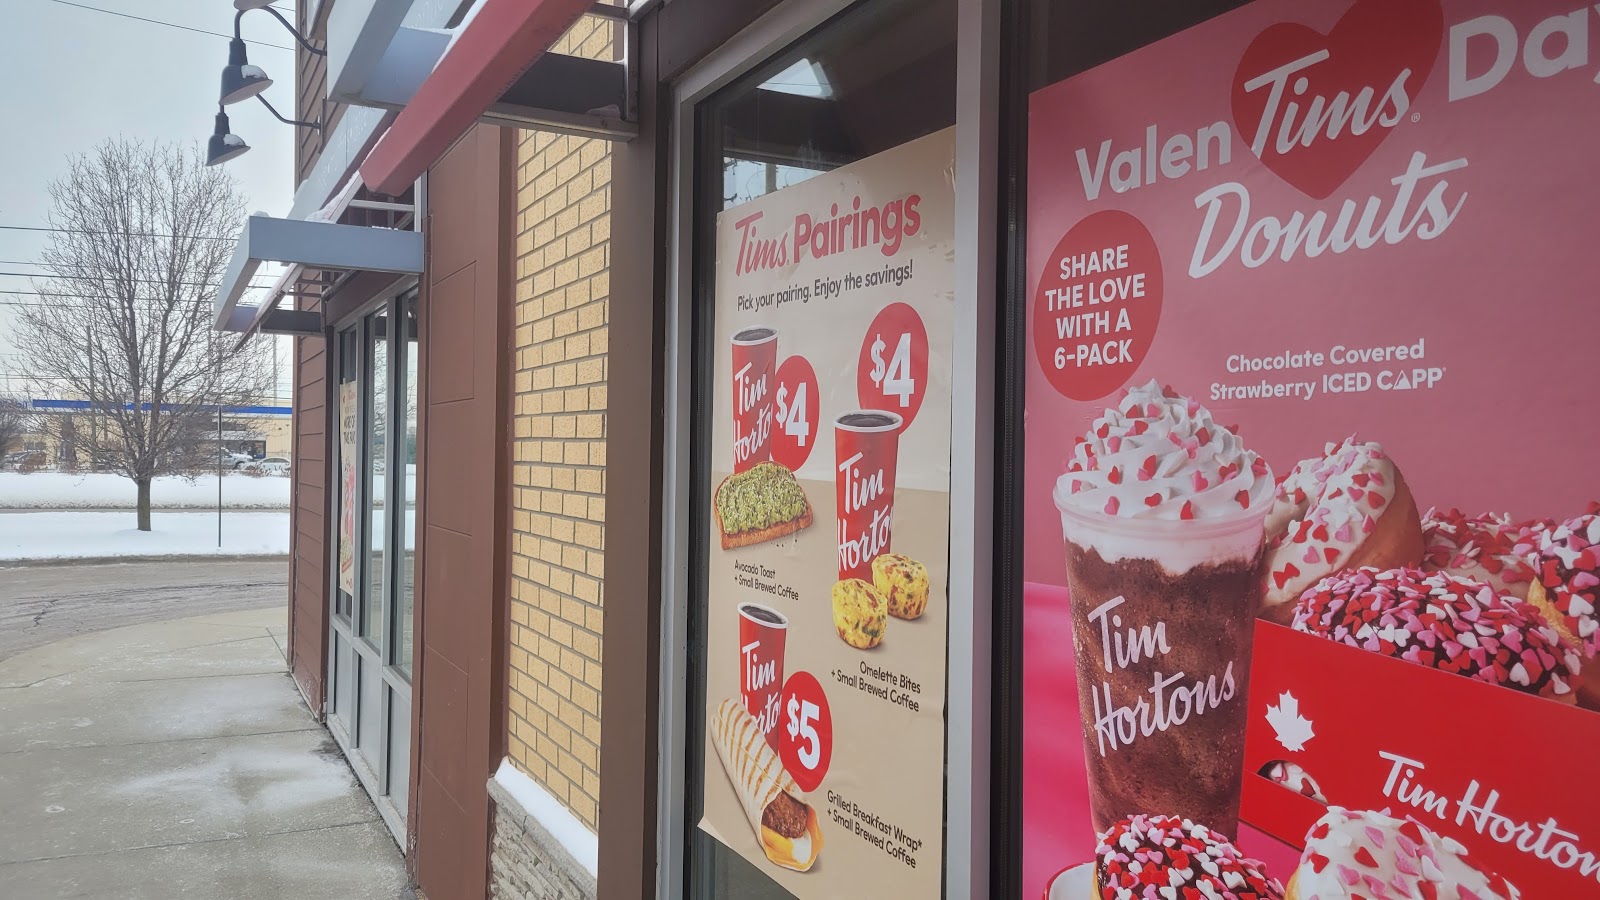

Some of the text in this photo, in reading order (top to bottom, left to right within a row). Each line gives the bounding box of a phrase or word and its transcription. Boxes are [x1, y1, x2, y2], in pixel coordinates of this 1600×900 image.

[793, 194, 921, 264] Pairings
[1188, 150, 1469, 279] Donuts
[737, 259, 913, 312] Pick your pairing. Enjoy the savings!
[1059, 244, 1129, 280] SHARE
[1045, 273, 1145, 312] THE LOVE
[1056, 307, 1132, 340] WITH A
[869, 333, 915, 408] $4
[1054, 339, 1133, 370] 6-PACK
[1226, 338, 1425, 373] Chocolate Covered
[734, 361, 767, 416] Tim
[1209, 380, 1316, 401] Strawberry
[1322, 372, 1372, 394] ICED
[775, 381, 809, 447] $4
[839, 451, 885, 514] Tim
[734, 559, 776, 579] Avocado Toast
[738, 574, 754, 588] Small
[754, 578, 776, 595] Brewed
[777, 584, 799, 601] Coffee
[1087, 595, 1171, 673] Tim
[742, 640, 776, 692] Tim
[837, 669, 858, 689] Small
[858, 677, 888, 700] Brewed
[889, 689, 920, 712] Coffee
[859, 660, 921, 694] Omelette Bites
[786, 692, 821, 770] $5
[1091, 660, 1235, 757] Hortons
[1378, 750, 1448, 819] Tim
[827, 789, 851, 814] Grilled
[852, 803, 892, 836] Breakfast
[833, 809, 854, 832] Small
[854, 821, 885, 851] Brewed
[885, 840, 917, 869] Coffee
